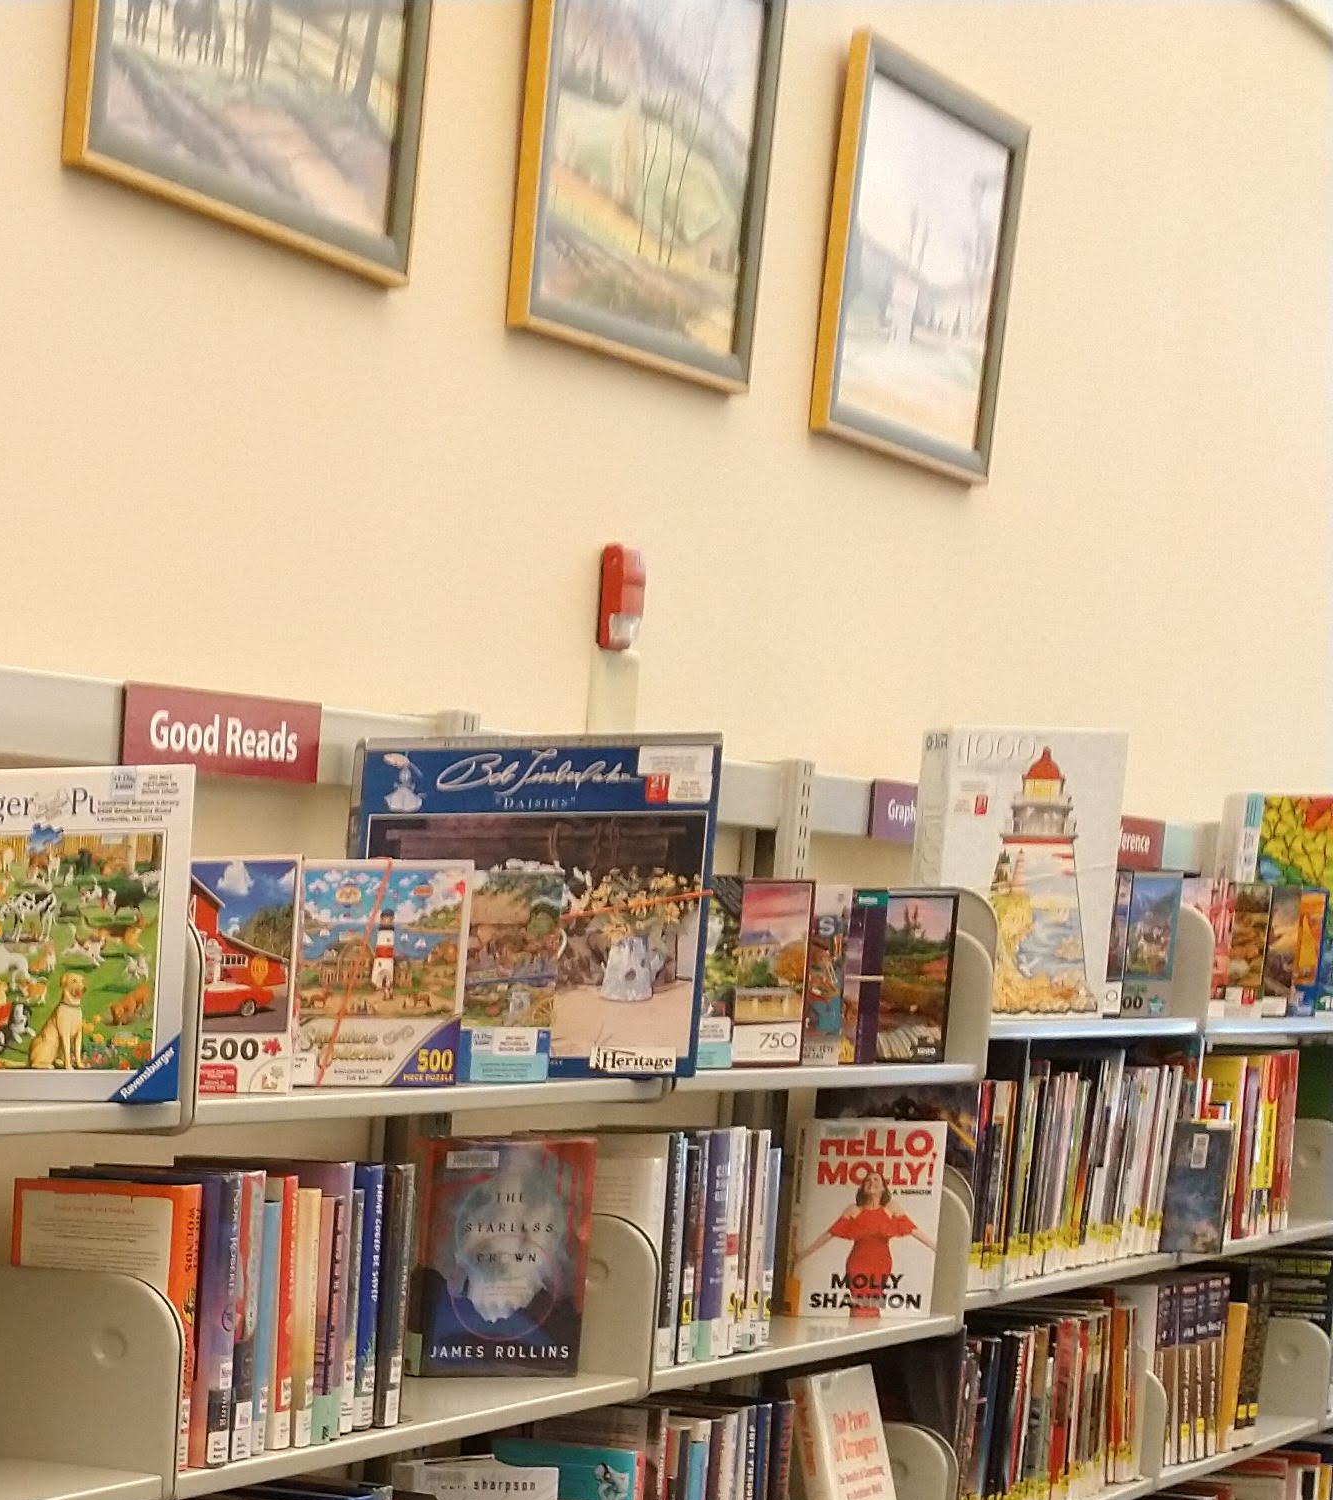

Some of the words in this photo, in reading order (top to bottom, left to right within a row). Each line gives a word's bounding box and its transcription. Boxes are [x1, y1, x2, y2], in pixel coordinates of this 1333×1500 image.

[149, 709, 220, 757] Good
[226, 715, 299, 763] Reads
[437, 753, 519, 791] Bob
[199, 1038, 260, 1061] 500
[759, 1032, 798, 1051] 750
[417, 1048, 453, 1072] 500
[600, 1049, 674, 1071] Heritage
[120, 1046, 176, 1099] Ravensburger
[816, 1161, 934, 1187] MOLLY!
[831, 1273, 903, 1291] MOLLY
[810, 1292, 921, 1310] SHANNON
[431, 1345, 486, 1361] JAMES
[495, 1344, 570, 1360] ROLLINS
